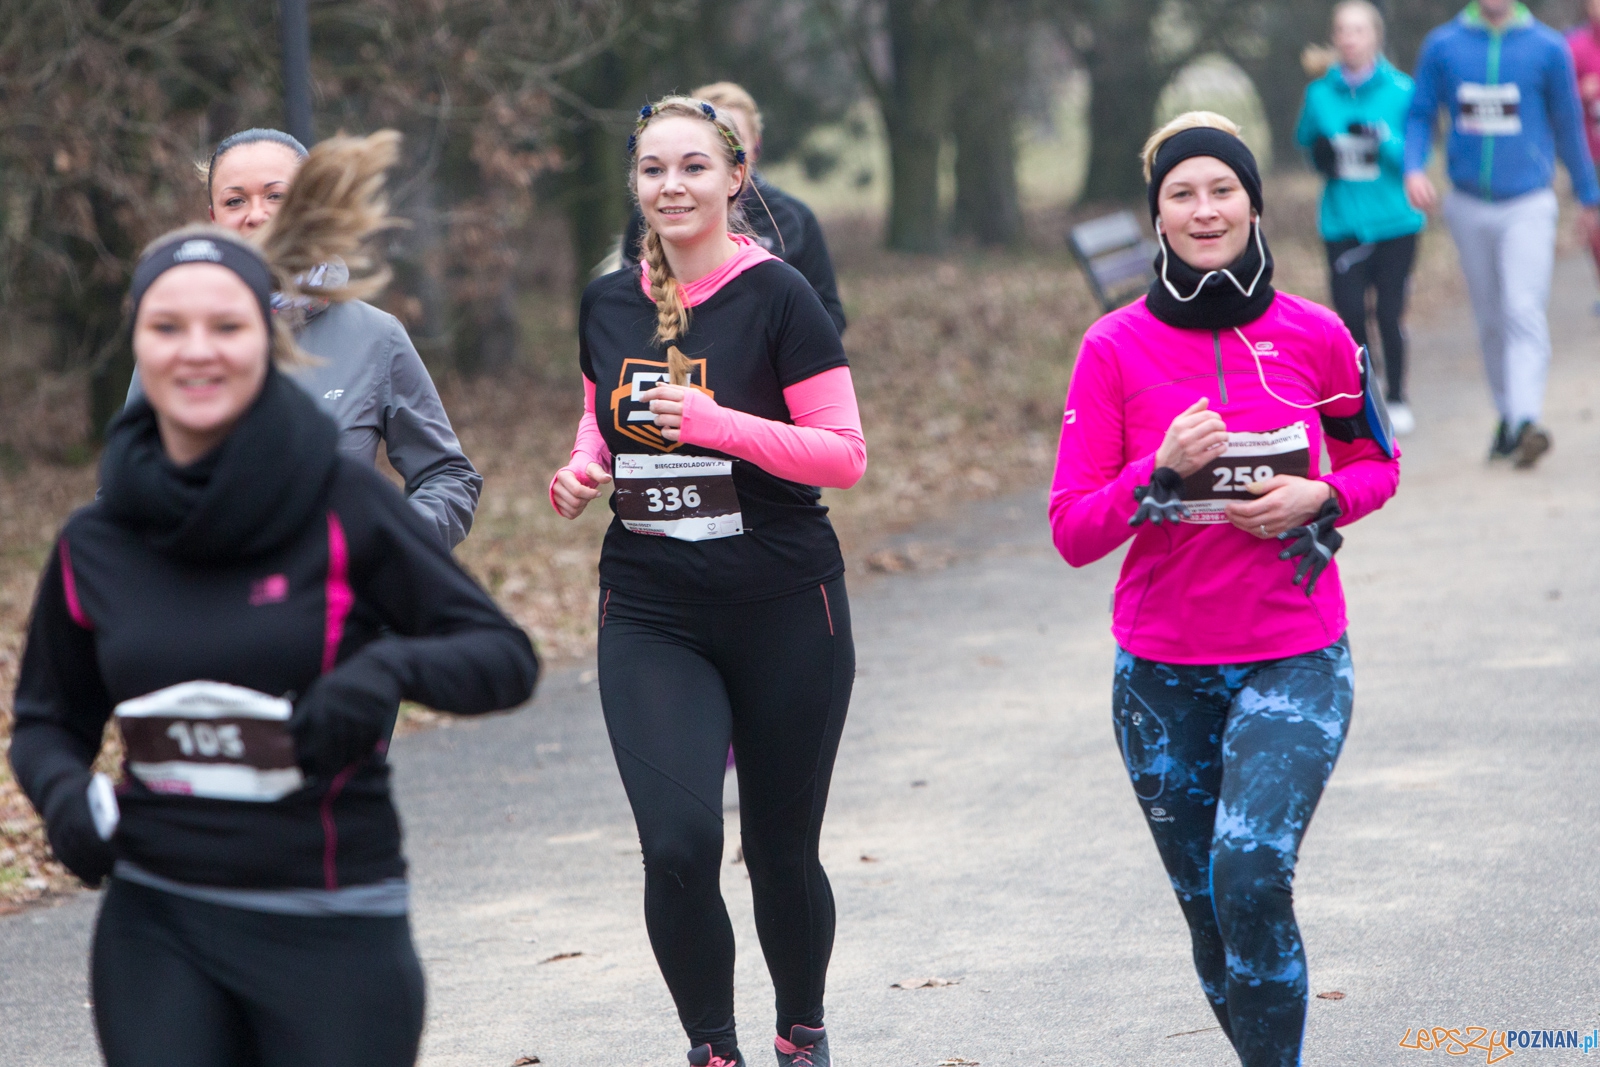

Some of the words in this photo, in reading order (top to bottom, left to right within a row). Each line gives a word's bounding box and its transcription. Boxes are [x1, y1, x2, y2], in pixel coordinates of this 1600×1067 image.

[654, 461, 726, 470] BIEGCZEKOLADOWY.PL
[645, 485, 701, 512] 336
[167, 721, 245, 759] 105
